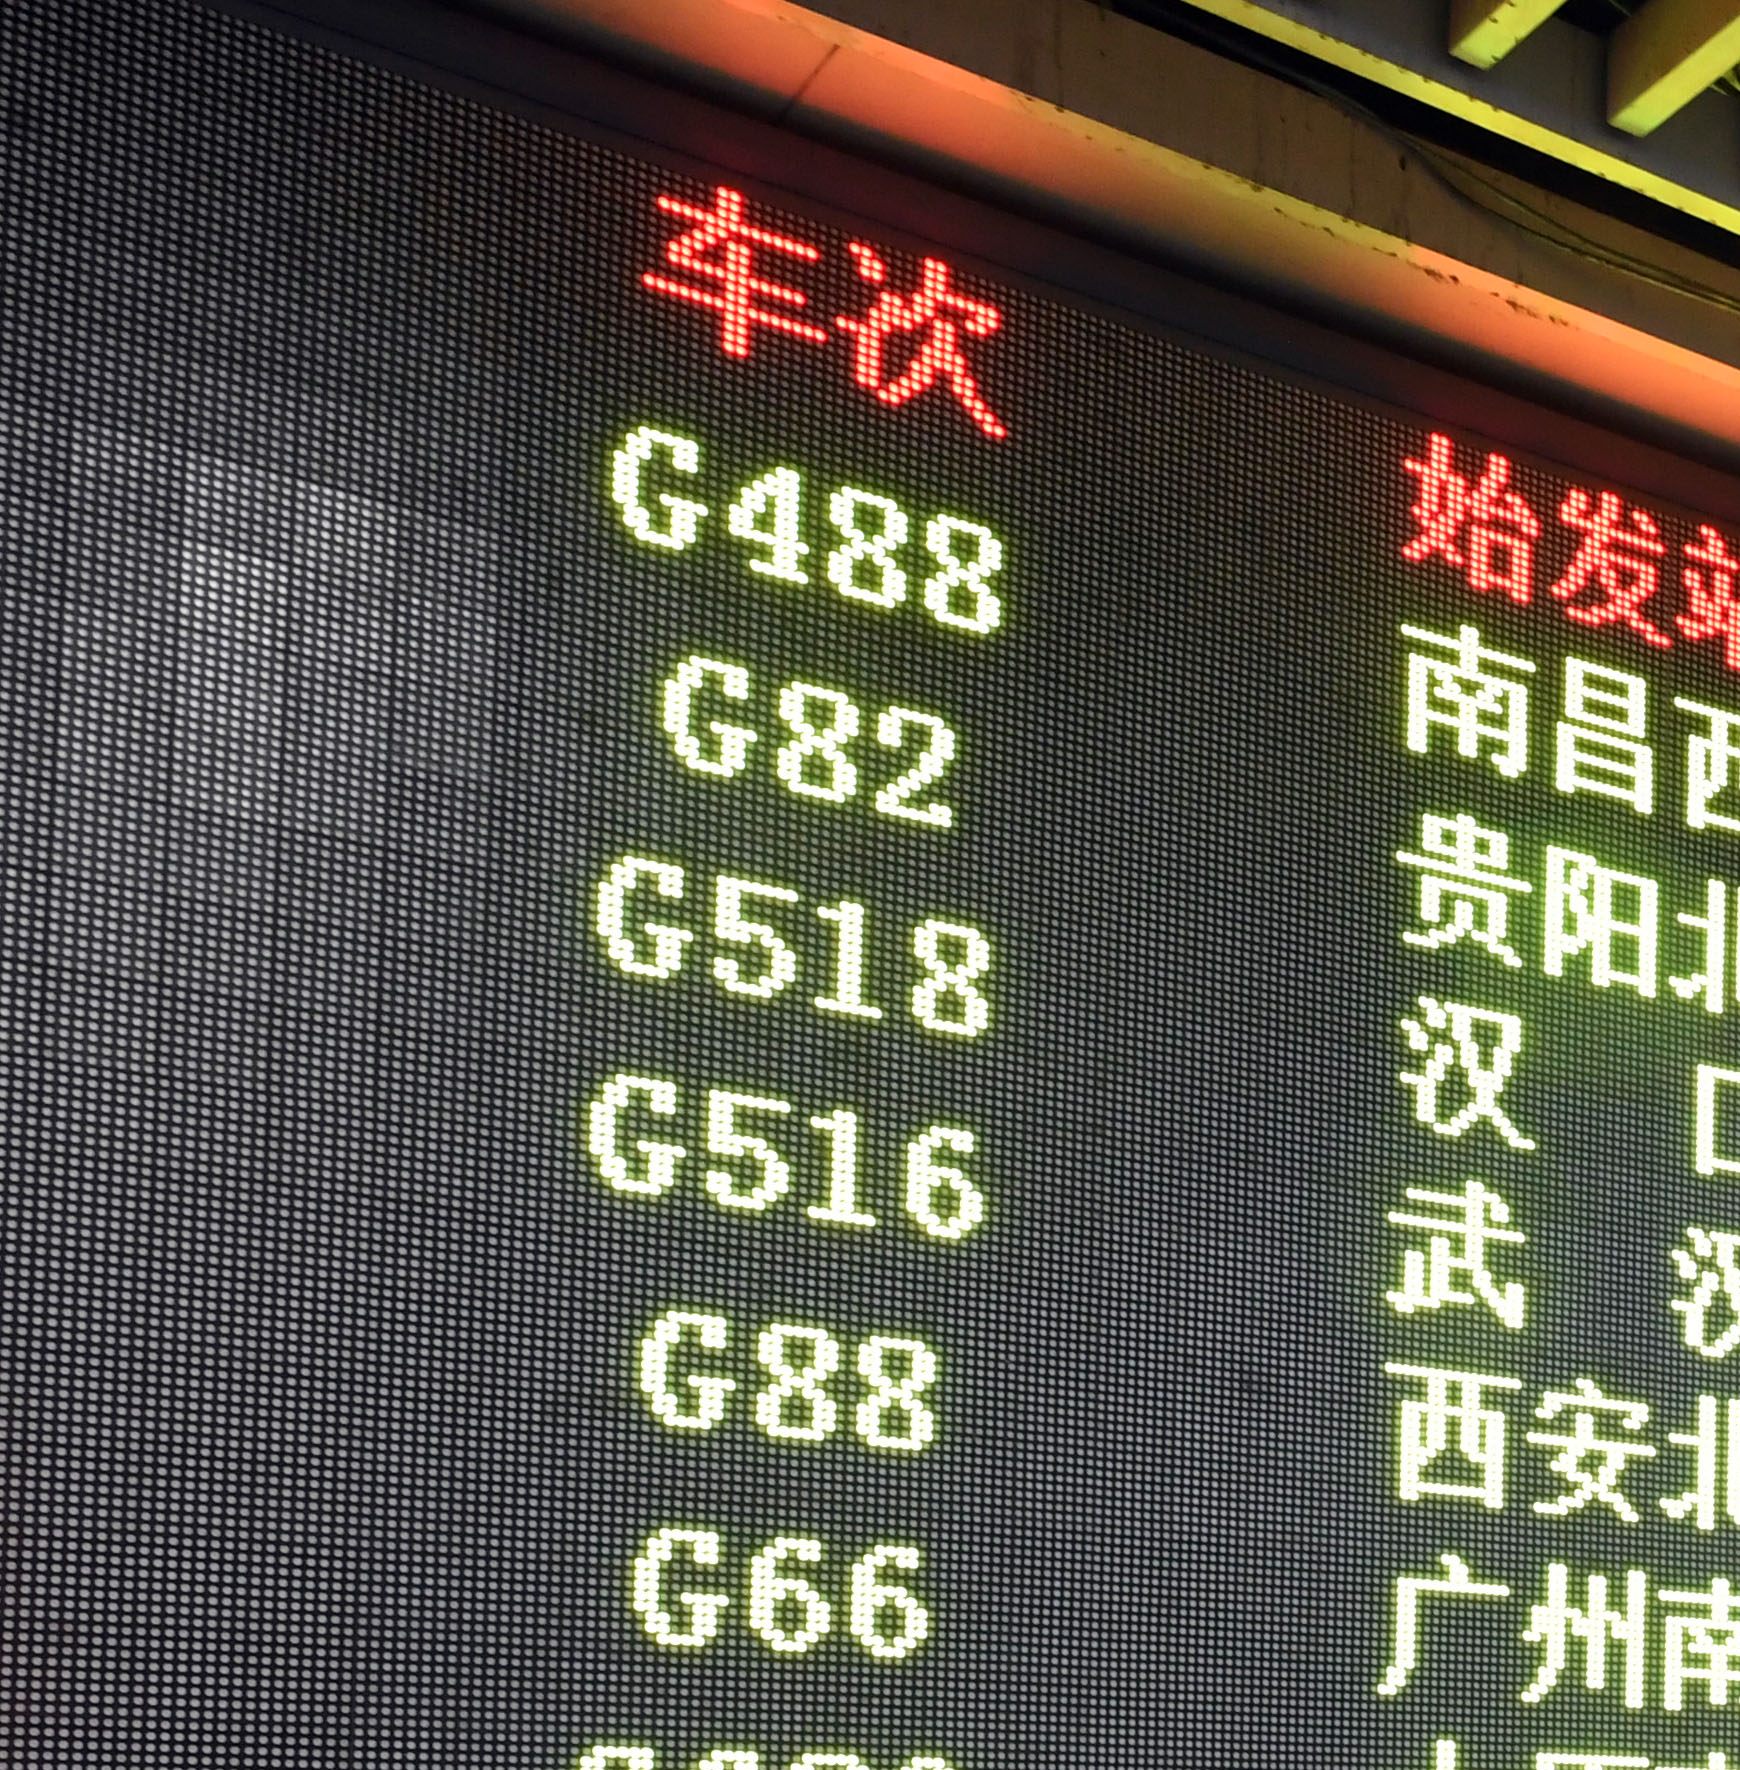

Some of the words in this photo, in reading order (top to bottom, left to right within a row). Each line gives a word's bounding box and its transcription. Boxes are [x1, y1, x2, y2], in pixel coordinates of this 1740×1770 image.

[641, 185, 1008, 440] 车次
[610, 425, 1003, 635] G488
[662, 654, 956, 829] G82
[595, 854, 991, 1038] G518
[587, 1072, 984, 1241] G516
[639, 1309, 938, 1452] G88
[632, 1526, 930, 1660] G66
